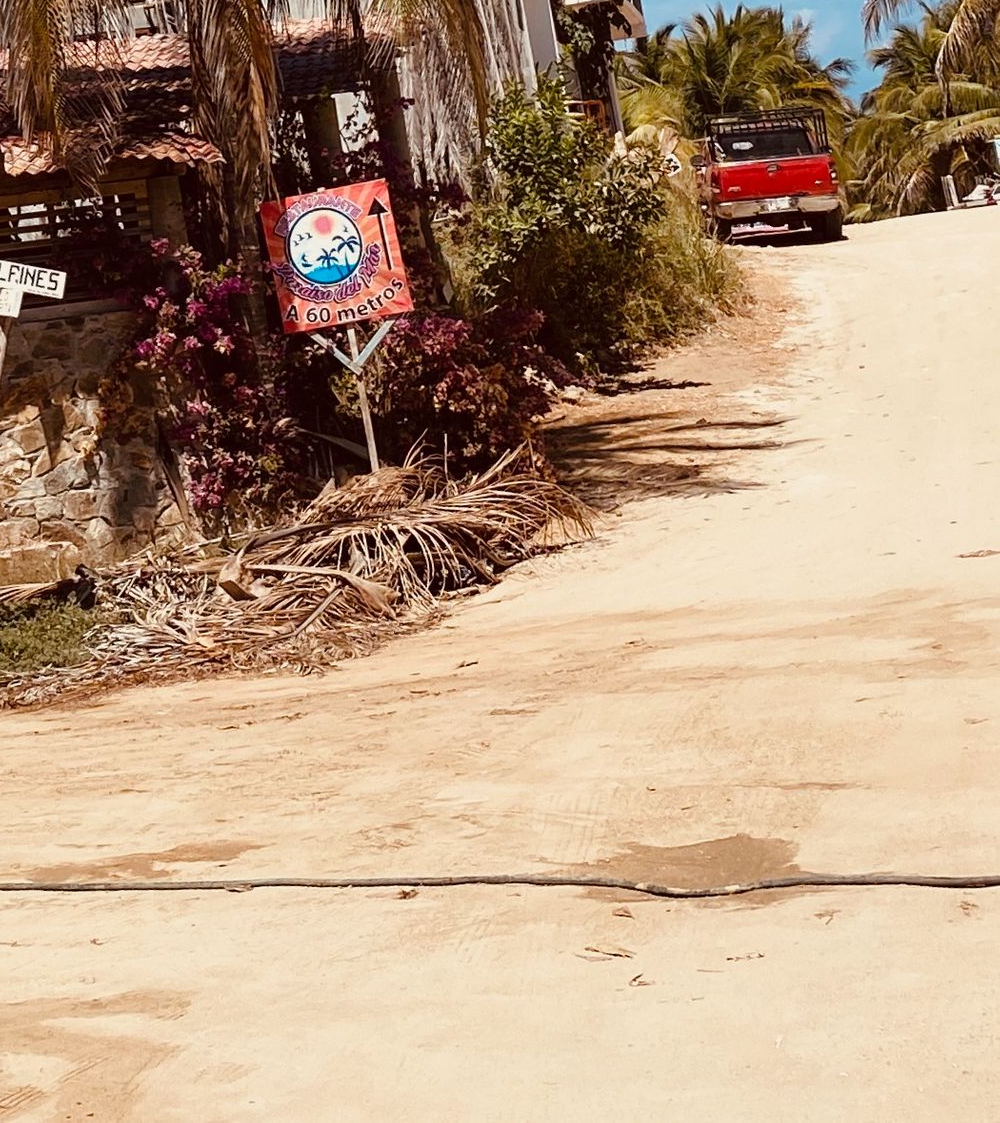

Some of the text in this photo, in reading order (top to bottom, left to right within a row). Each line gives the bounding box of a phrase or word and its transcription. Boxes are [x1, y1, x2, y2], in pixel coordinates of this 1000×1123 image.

[336, 276, 361, 300] del
[360, 244, 381, 286] Mar
[286, 278, 404, 322] A 60 metros
